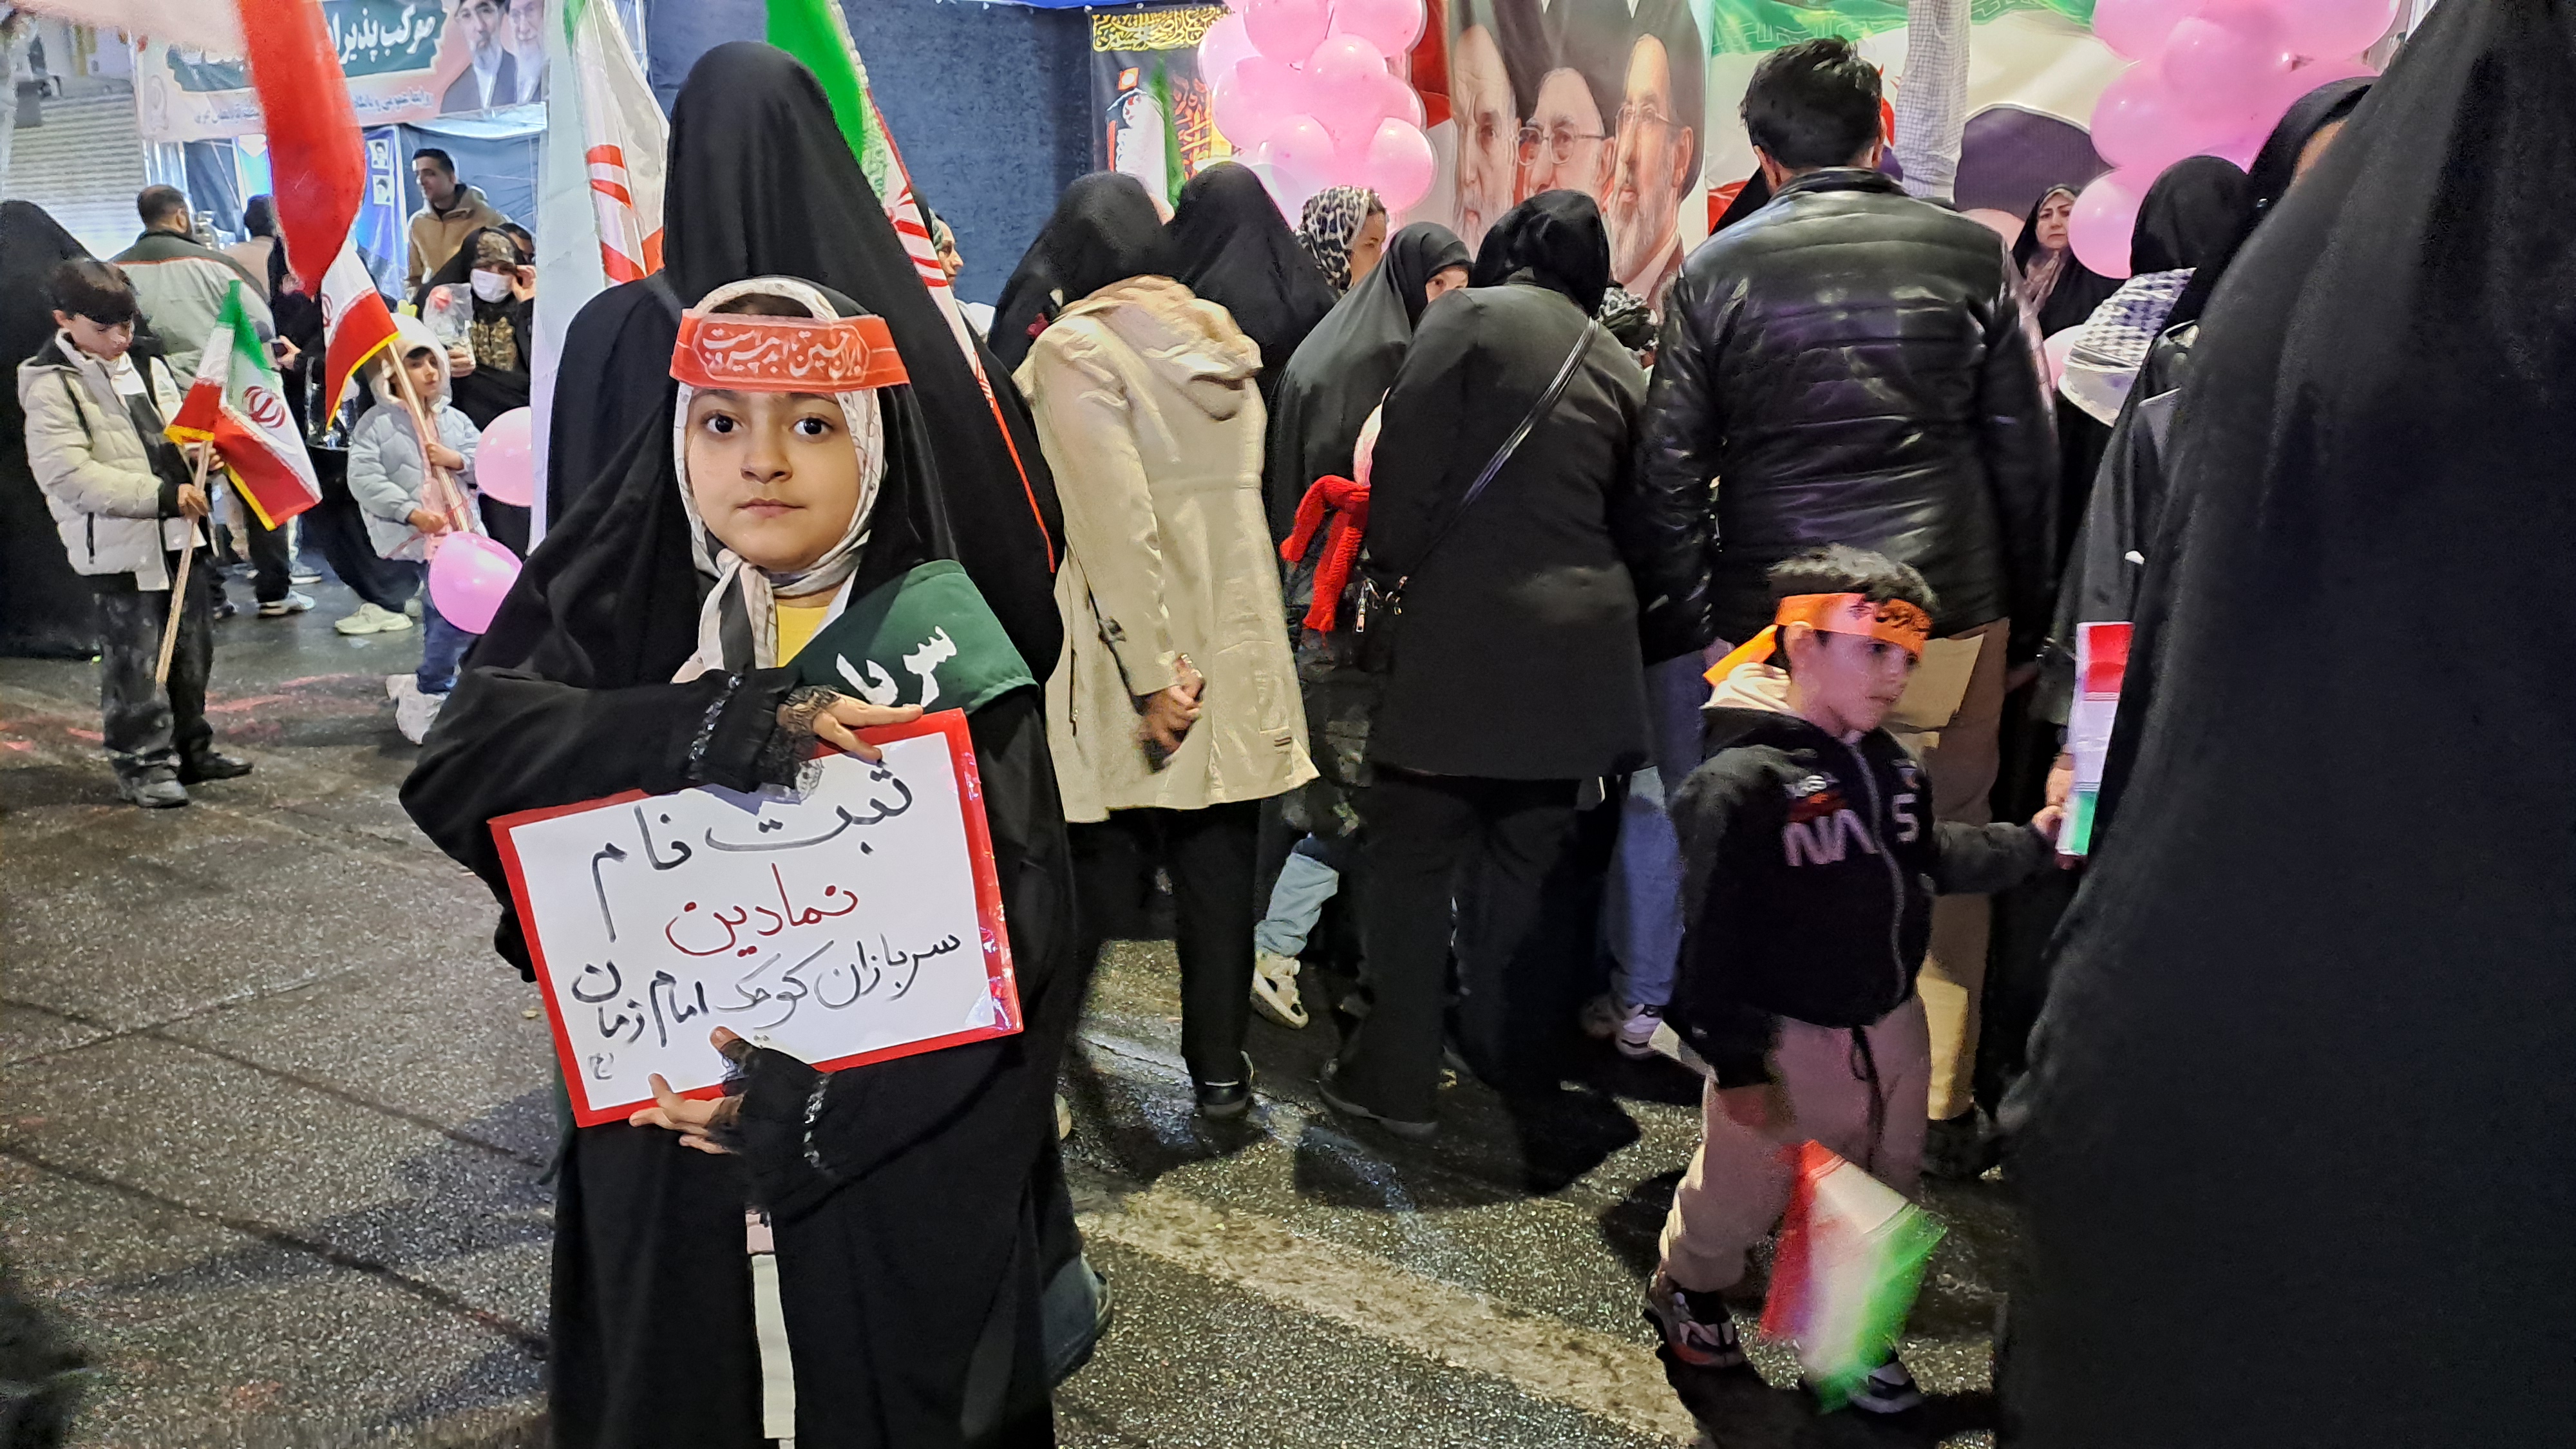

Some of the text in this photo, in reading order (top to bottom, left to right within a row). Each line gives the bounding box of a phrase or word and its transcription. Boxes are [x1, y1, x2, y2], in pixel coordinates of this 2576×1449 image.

[328, 4, 436, 64] موکب پذیرا
[837, 625, 958, 708] سربا
[591, 758, 913, 943] ثبت نام
[665, 862, 858, 957] نمادین
[571, 959, 646, 1044] زمان
[650, 969, 710, 1048] امام
[813, 933, 961, 1010] سربازان
